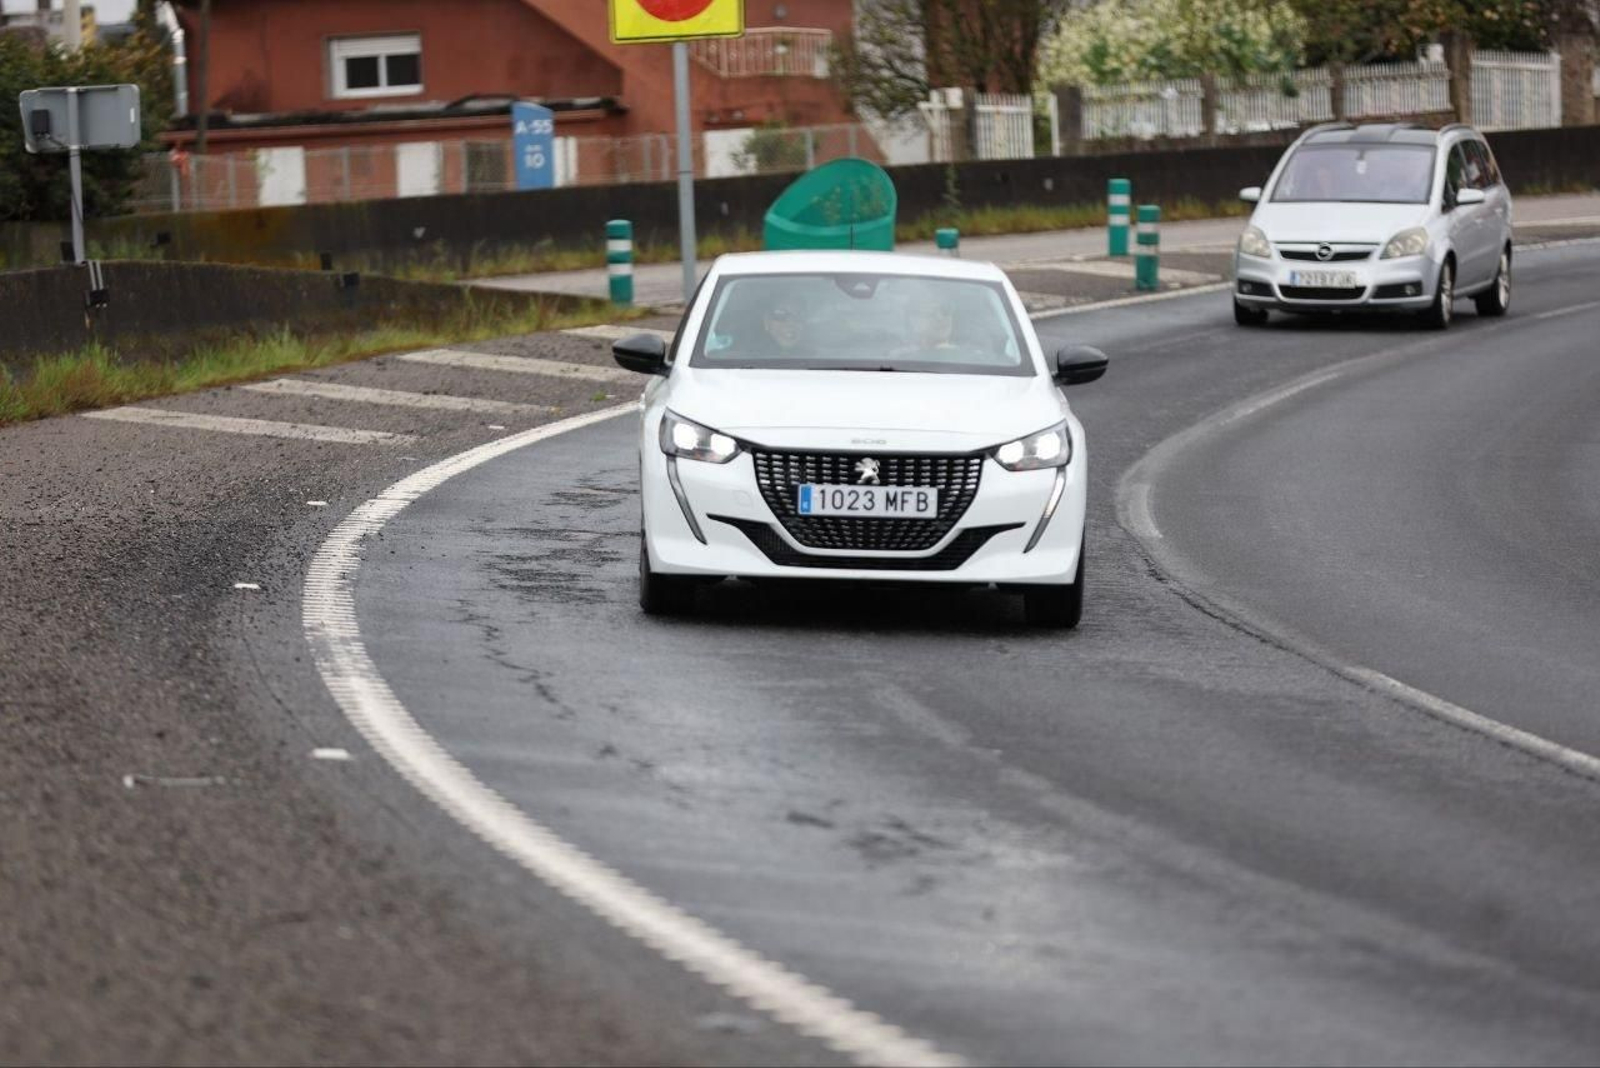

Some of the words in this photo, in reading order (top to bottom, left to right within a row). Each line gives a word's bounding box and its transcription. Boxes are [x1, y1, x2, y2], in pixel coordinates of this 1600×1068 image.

[525, 153, 546, 169] 10
[819, 489, 876, 511] 1023
[885, 491, 929, 513] MFB
